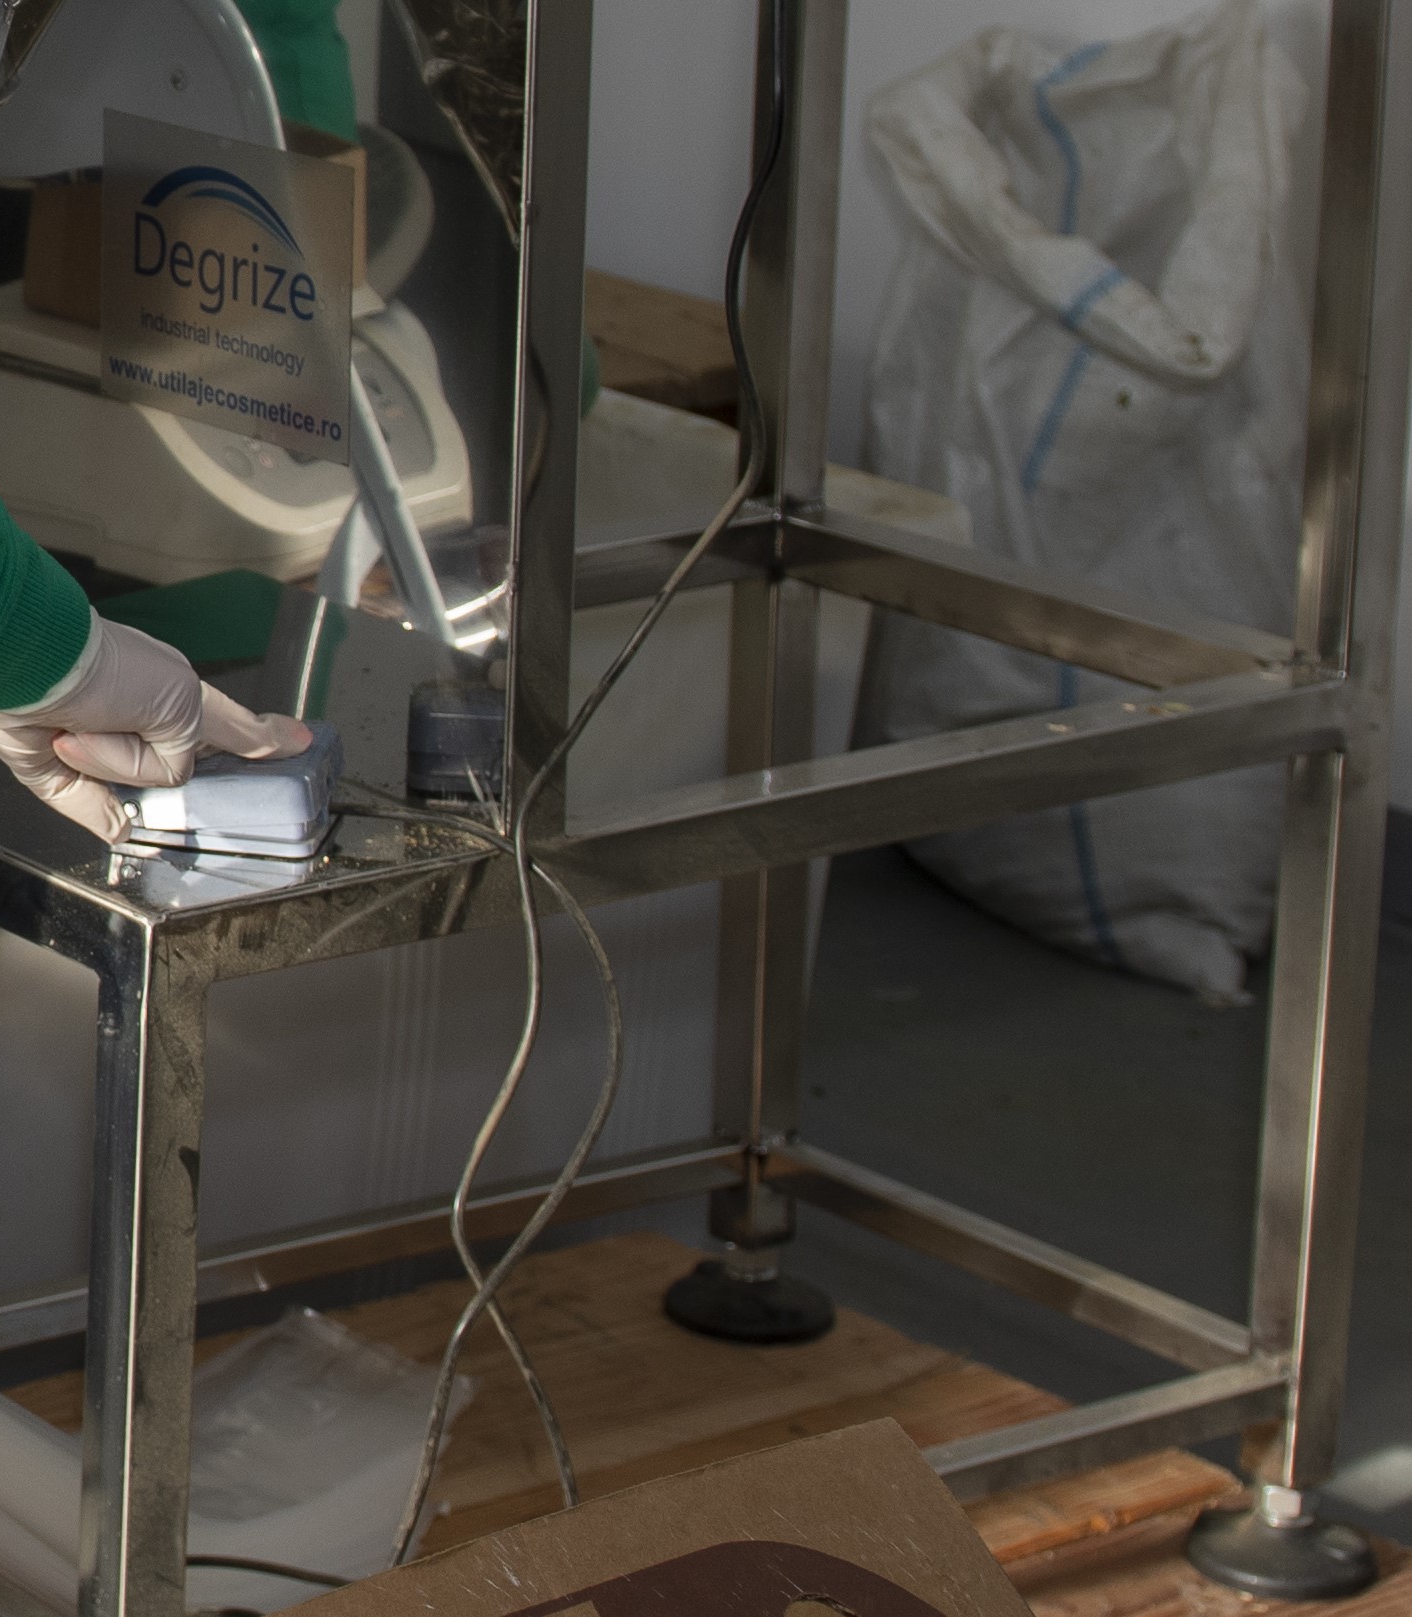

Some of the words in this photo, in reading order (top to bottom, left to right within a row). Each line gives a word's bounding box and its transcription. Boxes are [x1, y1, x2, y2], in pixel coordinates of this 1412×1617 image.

[134, 211, 316, 320] Degrize
[141, 308, 210, 345] industrial
[216, 329, 305, 376] technology
[109, 356, 342, 441] www.utilajecosmetice.ro
